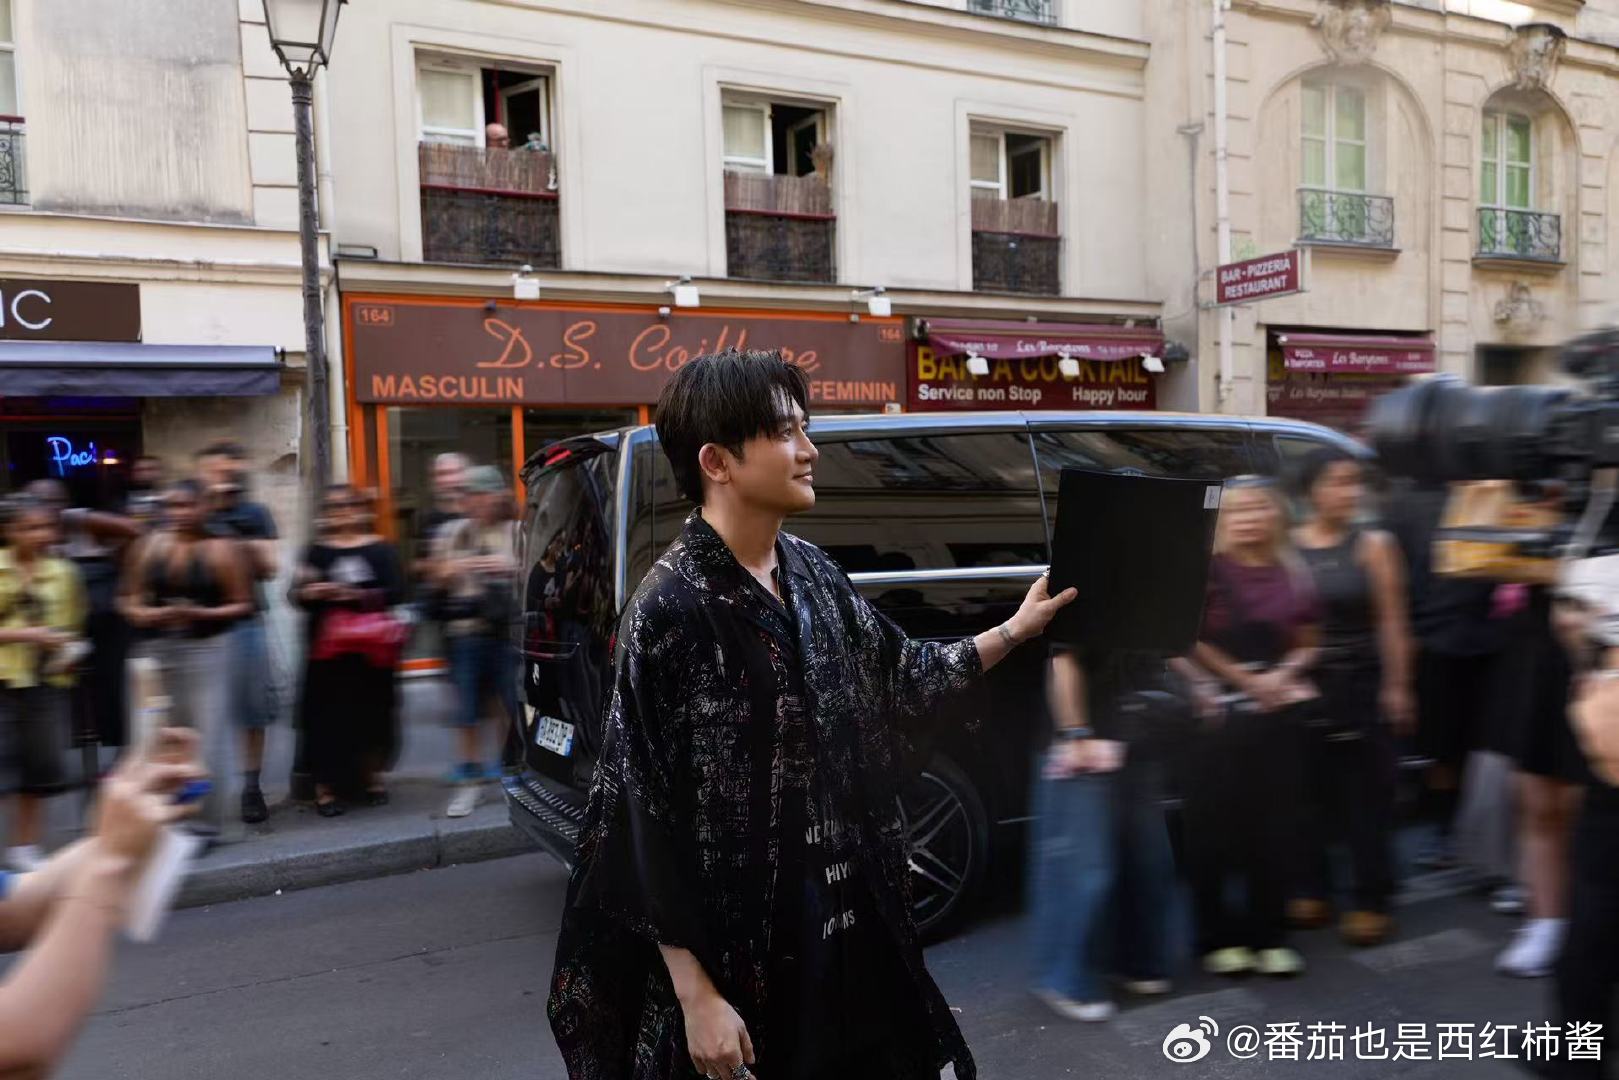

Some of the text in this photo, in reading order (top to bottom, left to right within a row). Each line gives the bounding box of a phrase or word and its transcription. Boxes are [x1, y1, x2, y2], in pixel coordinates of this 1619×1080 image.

[1225, 275, 1287, 299] RESTAURANT
[360, 309, 389, 323] 164
[371, 374, 524, 400] MASCULIN
[809, 380, 895, 402] FEMININ
[918, 384, 1042, 404] Service non Stop
[1072, 386, 1148, 405] Happy hour
